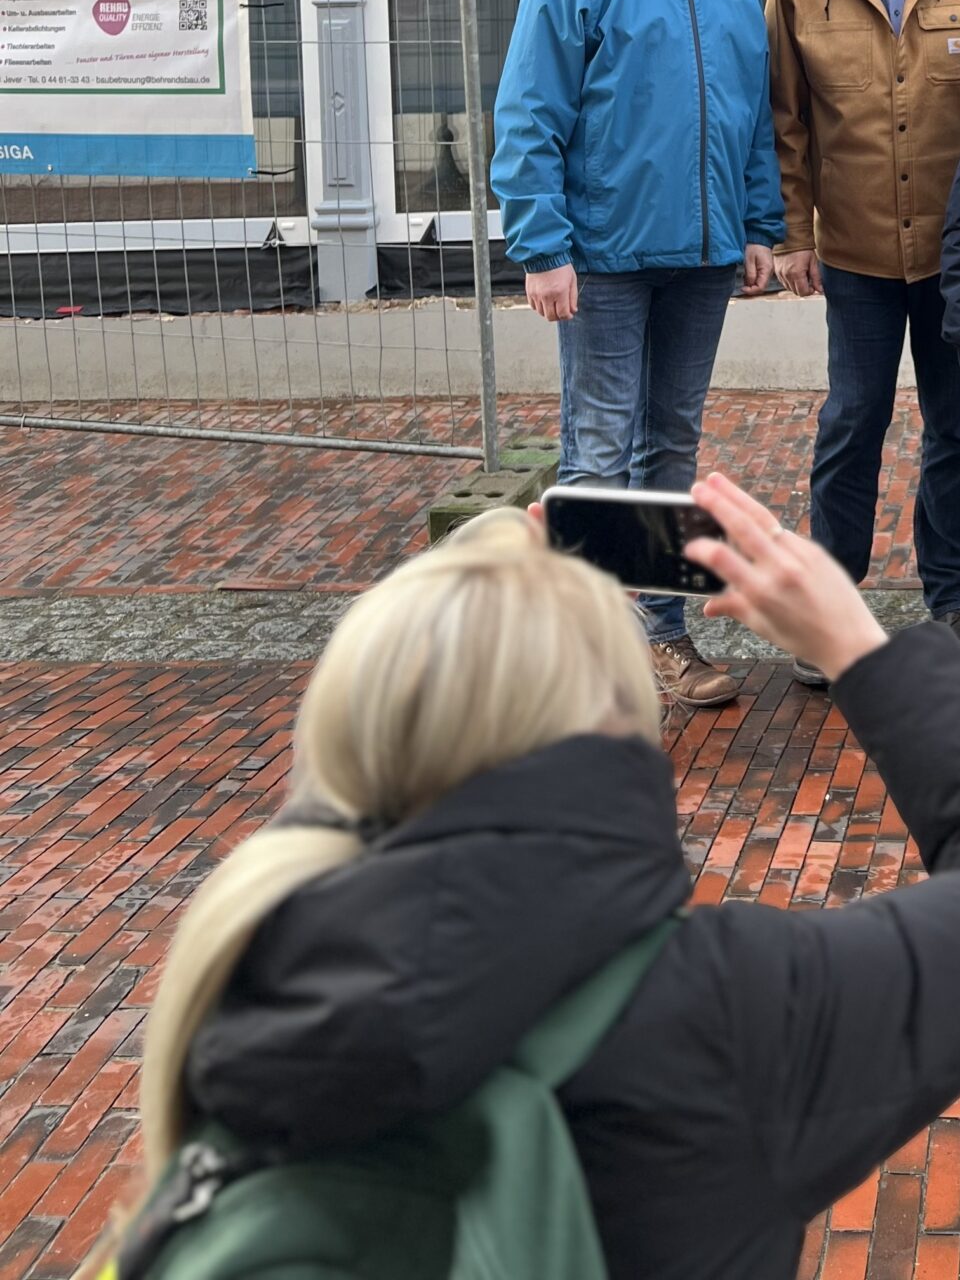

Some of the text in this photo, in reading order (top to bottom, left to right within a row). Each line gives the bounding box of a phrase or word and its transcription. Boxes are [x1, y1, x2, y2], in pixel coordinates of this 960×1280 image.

[99, 2, 129, 13] REHAU
[99, 13, 128, 22] QUALITY
[132, 13, 161, 21] ENERGIE
[8, 25, 66, 33] Kellerabdichtungen
[131, 23, 163, 31] EFFIZIENZ
[148, 51, 171, 61] eigener
[172, 47, 209, 57] Herstellung
[3, 75, 22, 84] Jever
[27, 75, 40, 84] Tel.
[41, 75, 47, 84] 0
[48, 75, 57, 83] 44
[80, 75, 90, 84] 43
